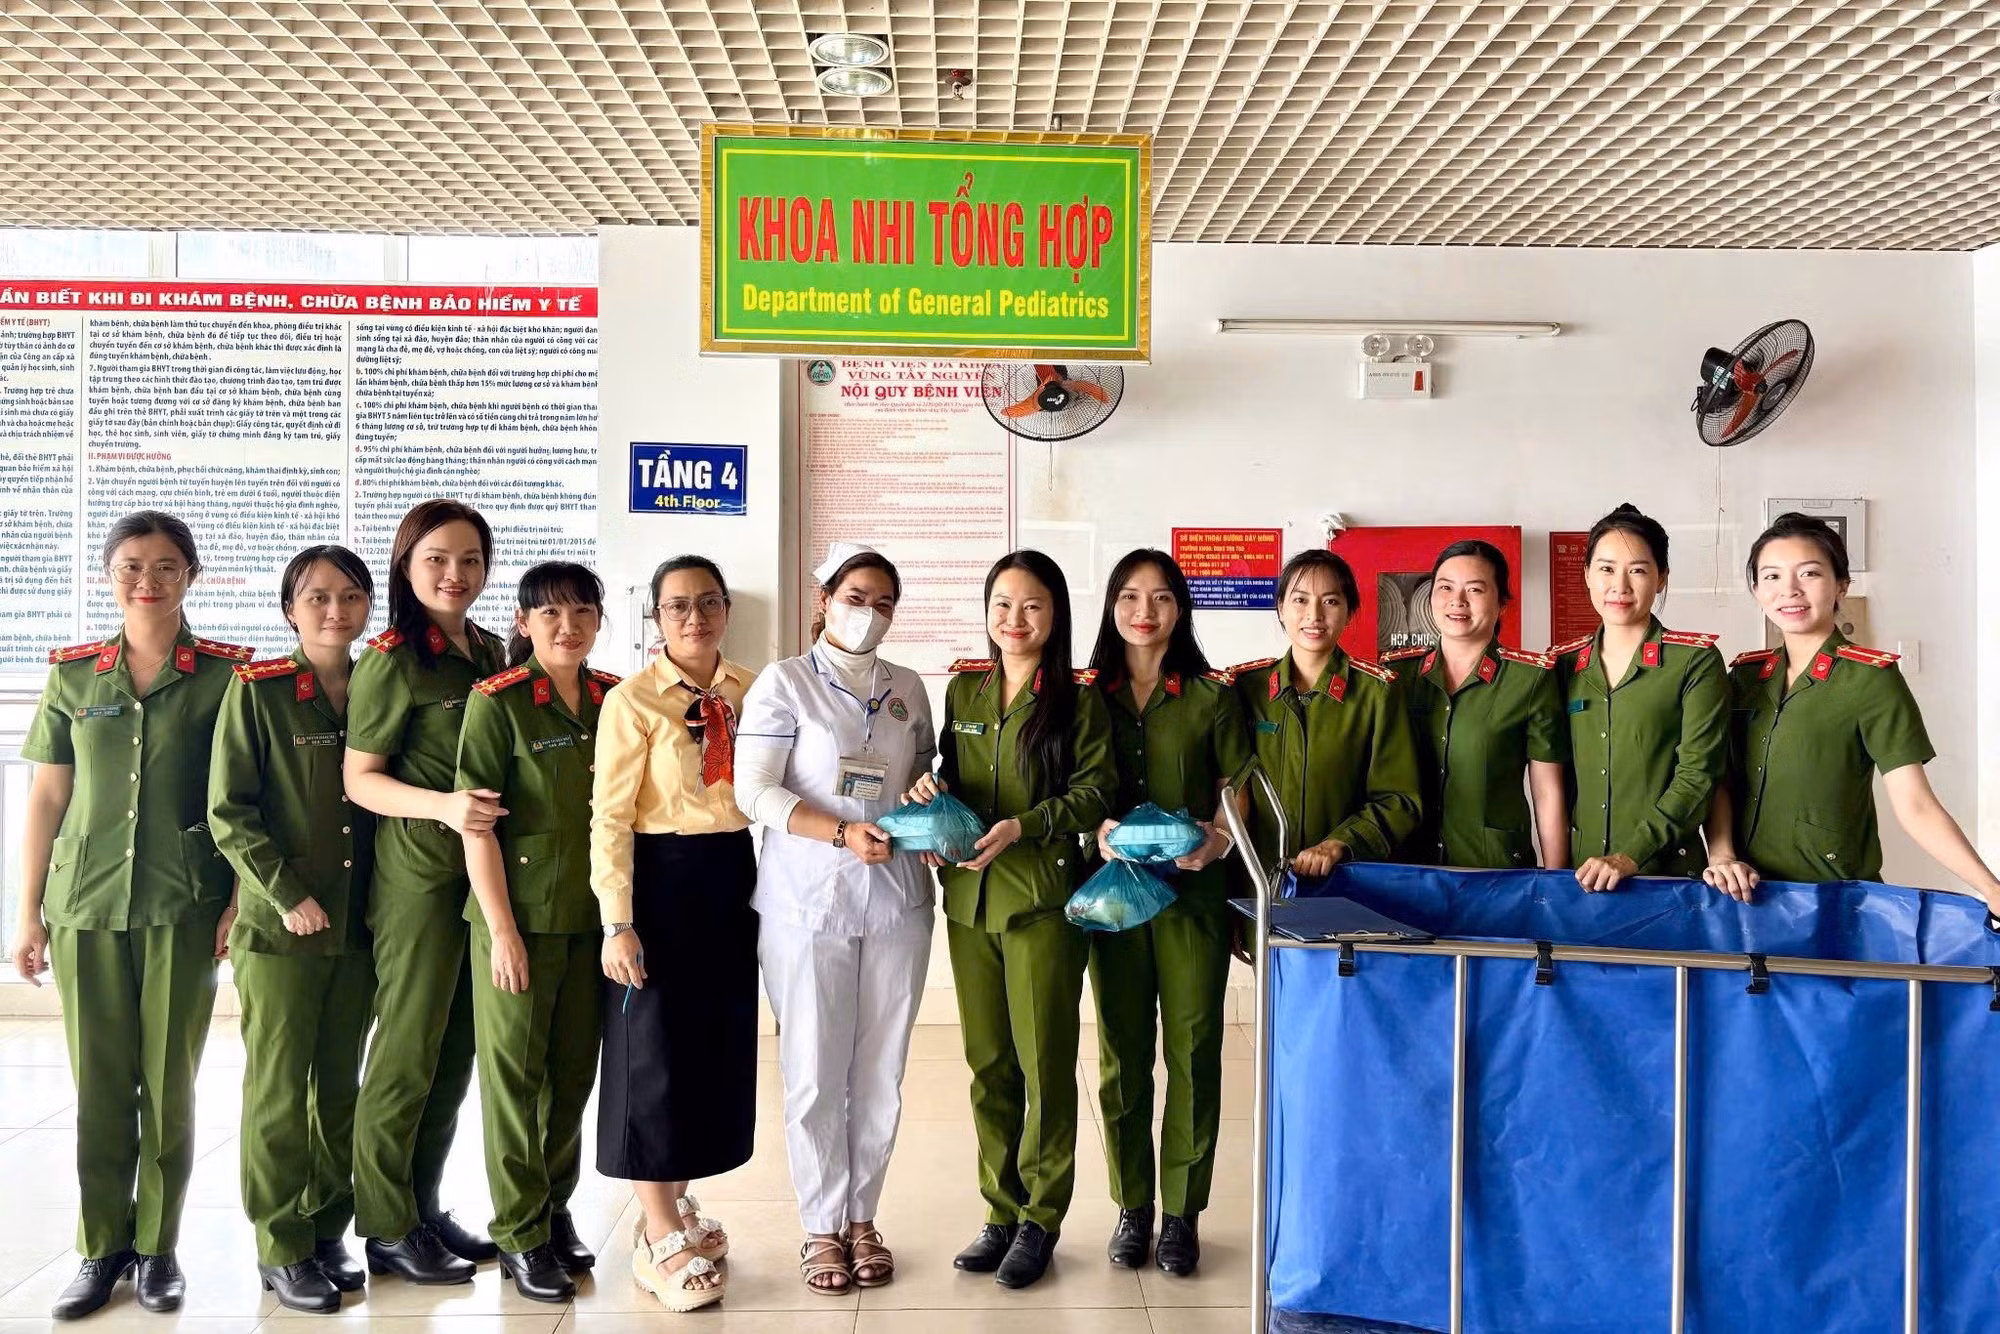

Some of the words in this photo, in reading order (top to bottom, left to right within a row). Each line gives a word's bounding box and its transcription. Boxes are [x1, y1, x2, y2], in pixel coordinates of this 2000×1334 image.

[738, 195, 840, 264] KHOA
[852, 199, 915, 264] NHI
[928, 171, 1024, 268] TỔNG
[1039, 194, 1114, 284] HỢP
[36, 288, 82, 304] BIẾT
[88, 292, 124, 304] KHI
[130, 292, 152, 306] ĐI
[158, 292, 222, 306] KHÁM
[230, 292, 293, 310] BỆNH,
[302, 291, 358, 309] CHỮA
[366, 294, 422, 311] BỆNH
[430, 294, 471, 310] BẢO
[478, 294, 531, 312] HIỂM
[538, 298, 550, 311] Y
[558, 294, 582, 312] TẾ
[743, 284, 872, 318] Department
[879, 288, 900, 314] of
[908, 288, 991, 316] General
[1000, 290, 1109, 318] Pediatrics
[840, 383, 869, 399] NỘI
[875, 386, 907, 400] QUY
[914, 383, 957, 400] BỆNH
[638, 450, 712, 489] TẦNG
[721, 462, 738, 490] 4
[655, 494, 678, 508] 4th
[683, 495, 720, 508] Floor
